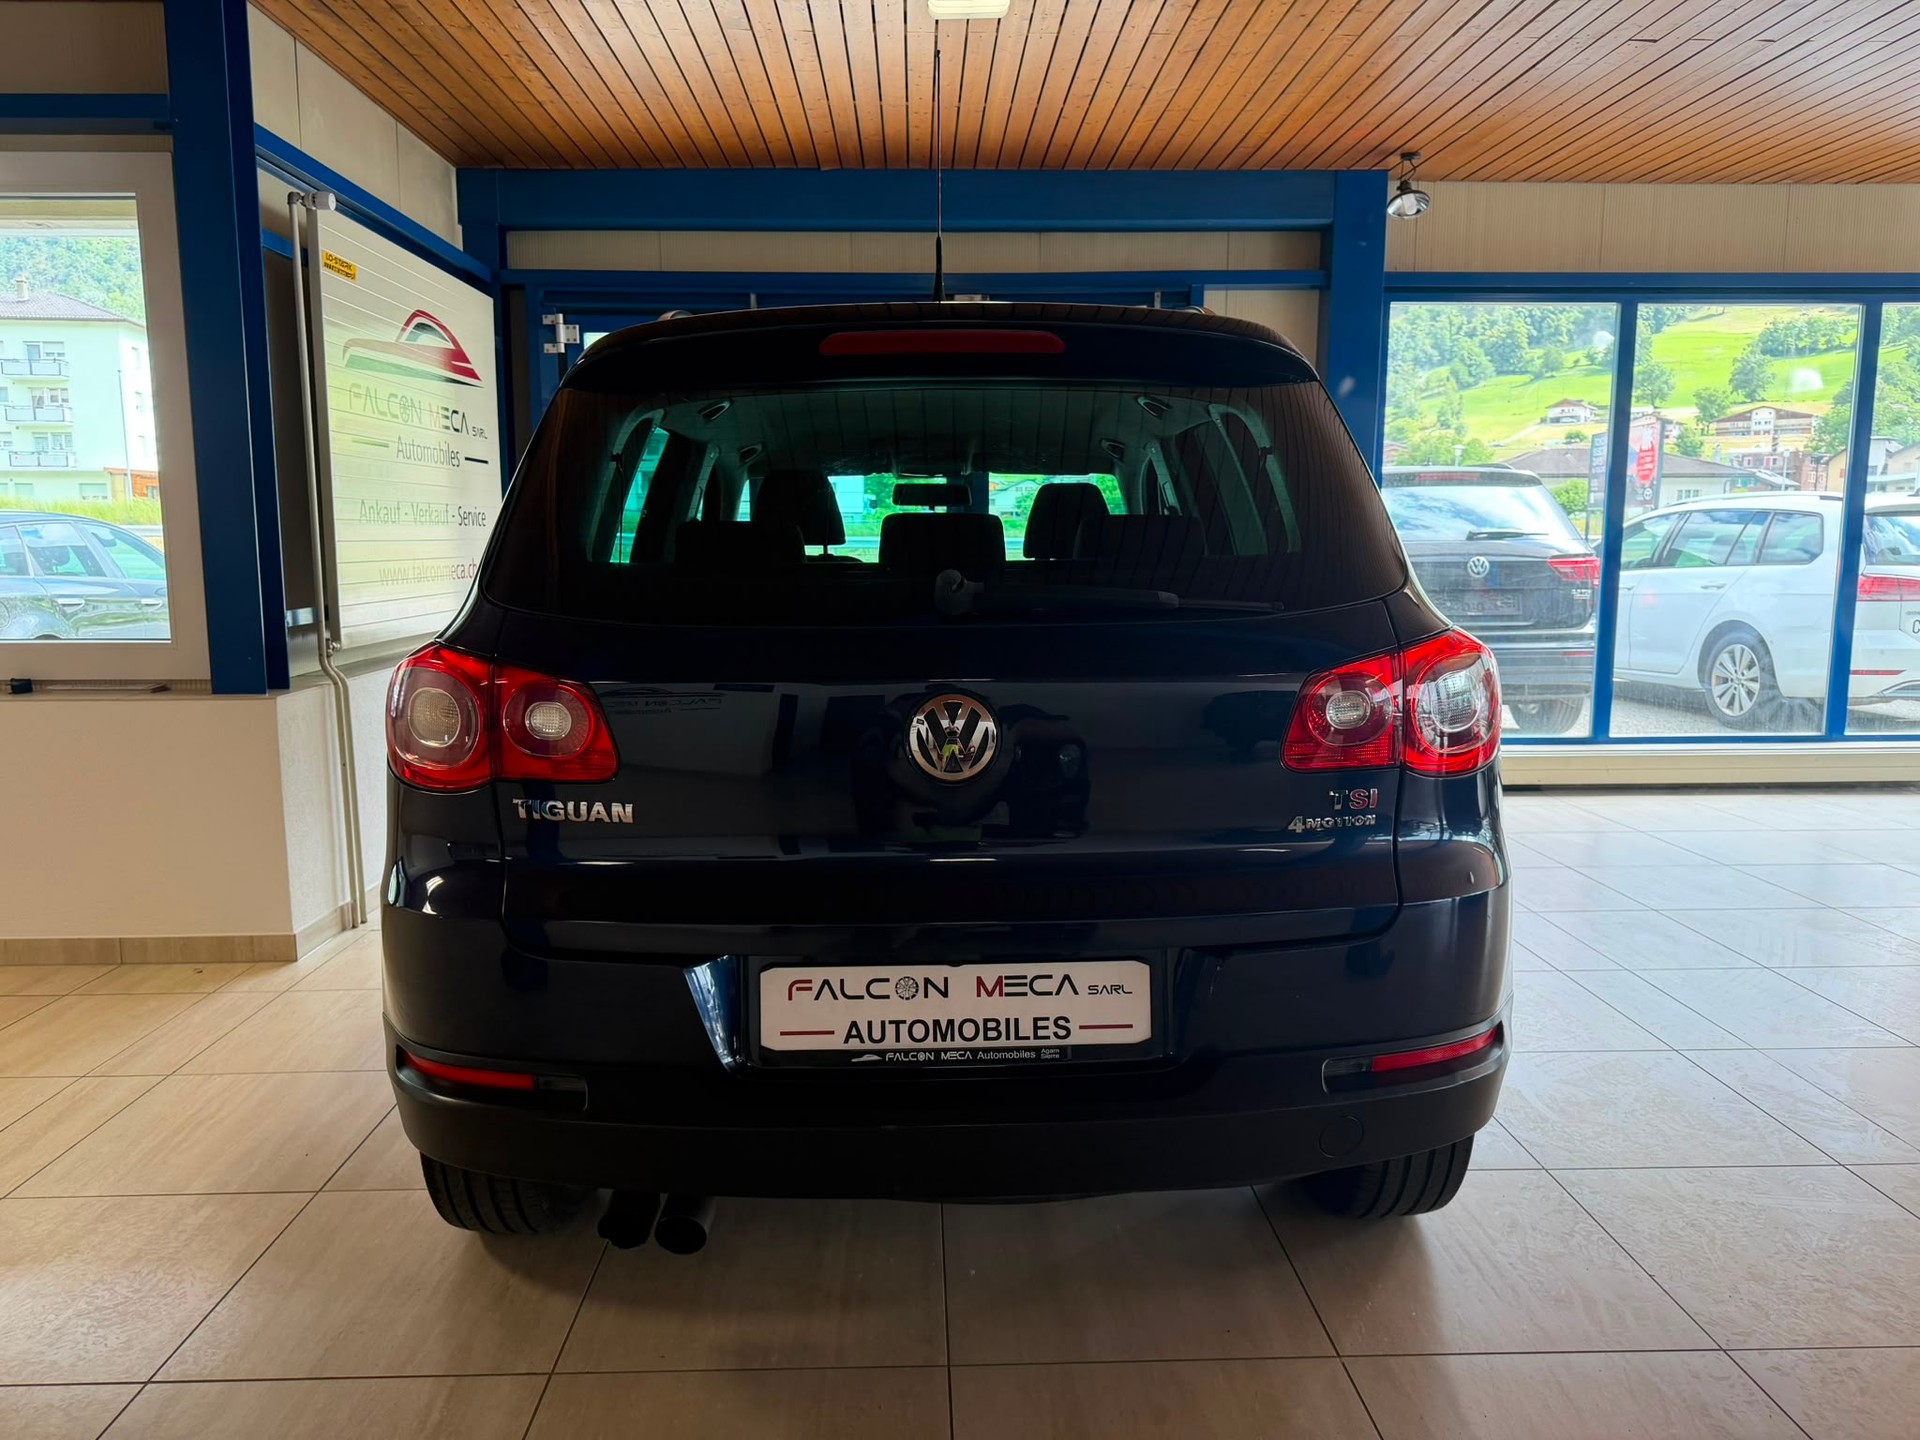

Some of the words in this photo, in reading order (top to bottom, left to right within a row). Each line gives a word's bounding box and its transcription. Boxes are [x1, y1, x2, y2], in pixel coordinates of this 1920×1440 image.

[349, 383, 422, 424] FALCON
[429, 402, 469, 435] MECA
[396, 434, 461, 468] Automobiles
[359, 498, 401, 525] Ankauf
[411, 502, 449, 526] Verkauf
[457, 506, 487, 527] Service
[512, 798, 634, 824] TIGUAN
[1329, 788, 1378, 810] TSI
[788, 976, 949, 1001] FALCON
[976, 974, 1079, 998] MECA
[1088, 984, 1133, 995] SARL
[843, 1015, 1072, 1045] AUTOMOBILES
[885, 1051, 934, 1061] FALCON
[940, 1050, 973, 1060] MECA
[977, 1049, 1036, 1060] Automobiles
